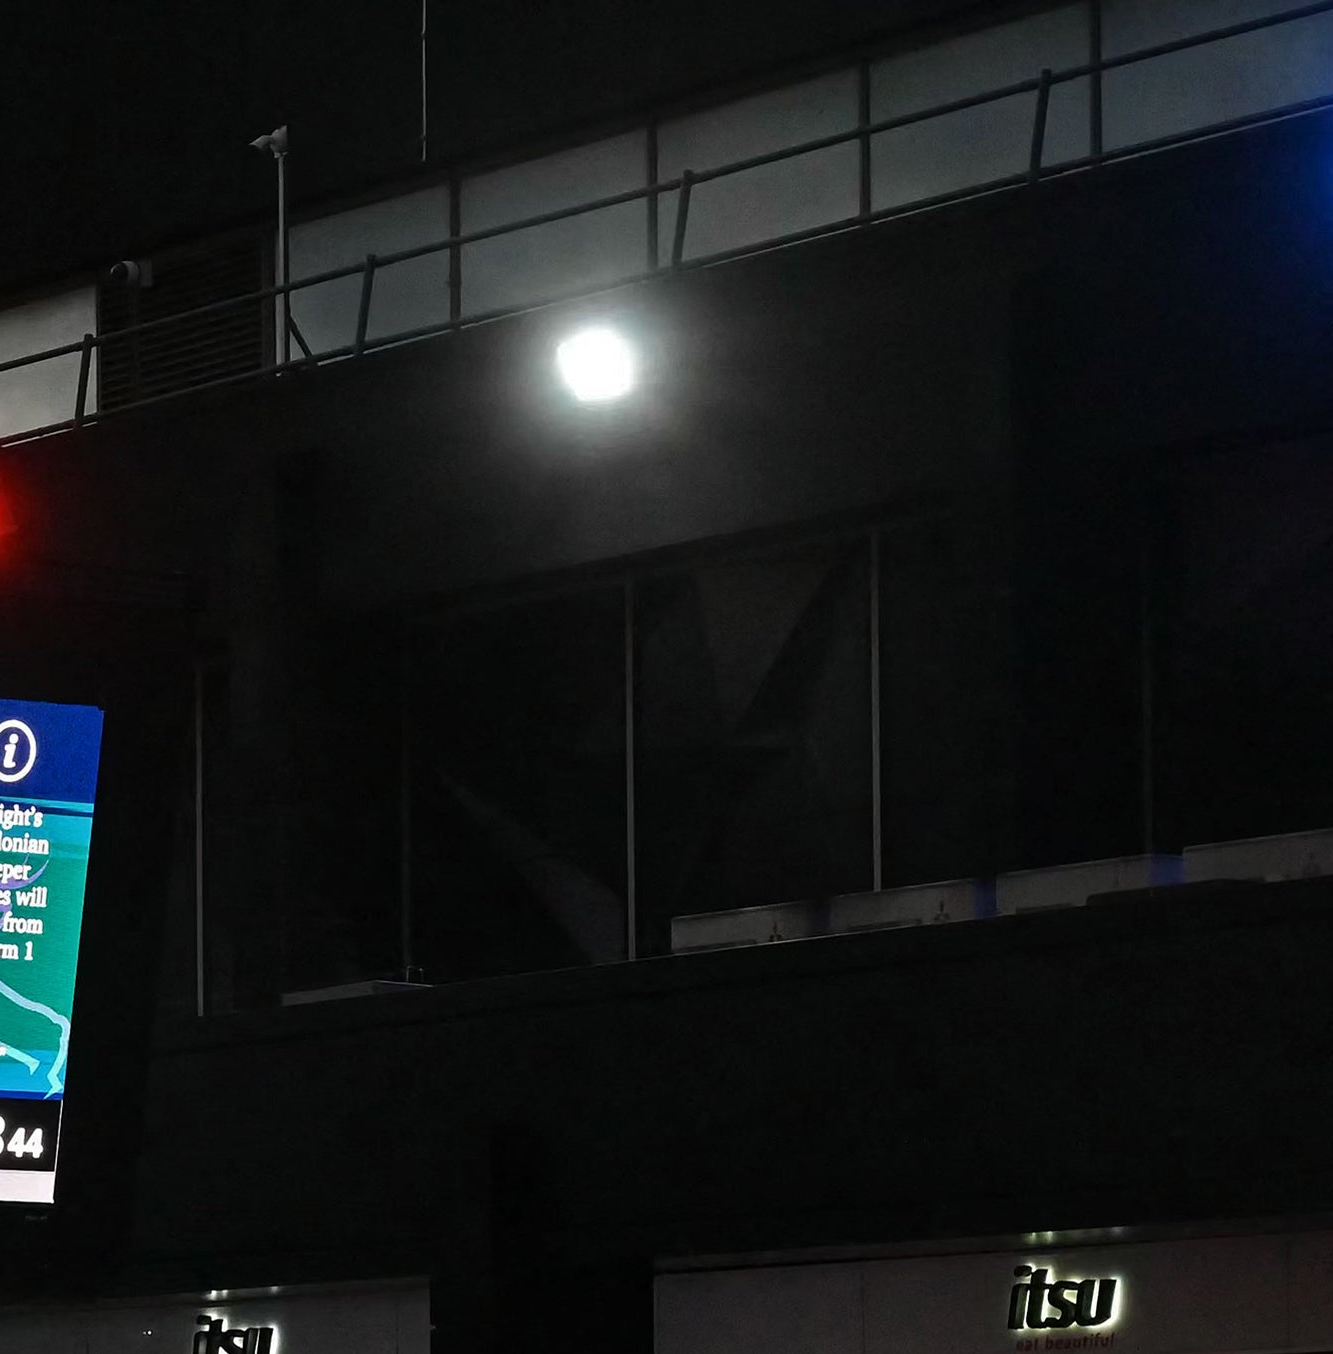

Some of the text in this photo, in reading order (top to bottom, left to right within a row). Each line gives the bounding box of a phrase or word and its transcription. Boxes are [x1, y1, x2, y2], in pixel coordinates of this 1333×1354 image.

[15, 888, 47, 908] will
[3, 911, 43, 934] from
[24, 937, 33, 960] 1
[8, 1127, 43, 1159] 44
[1008, 1266, 1117, 1329] itsu
